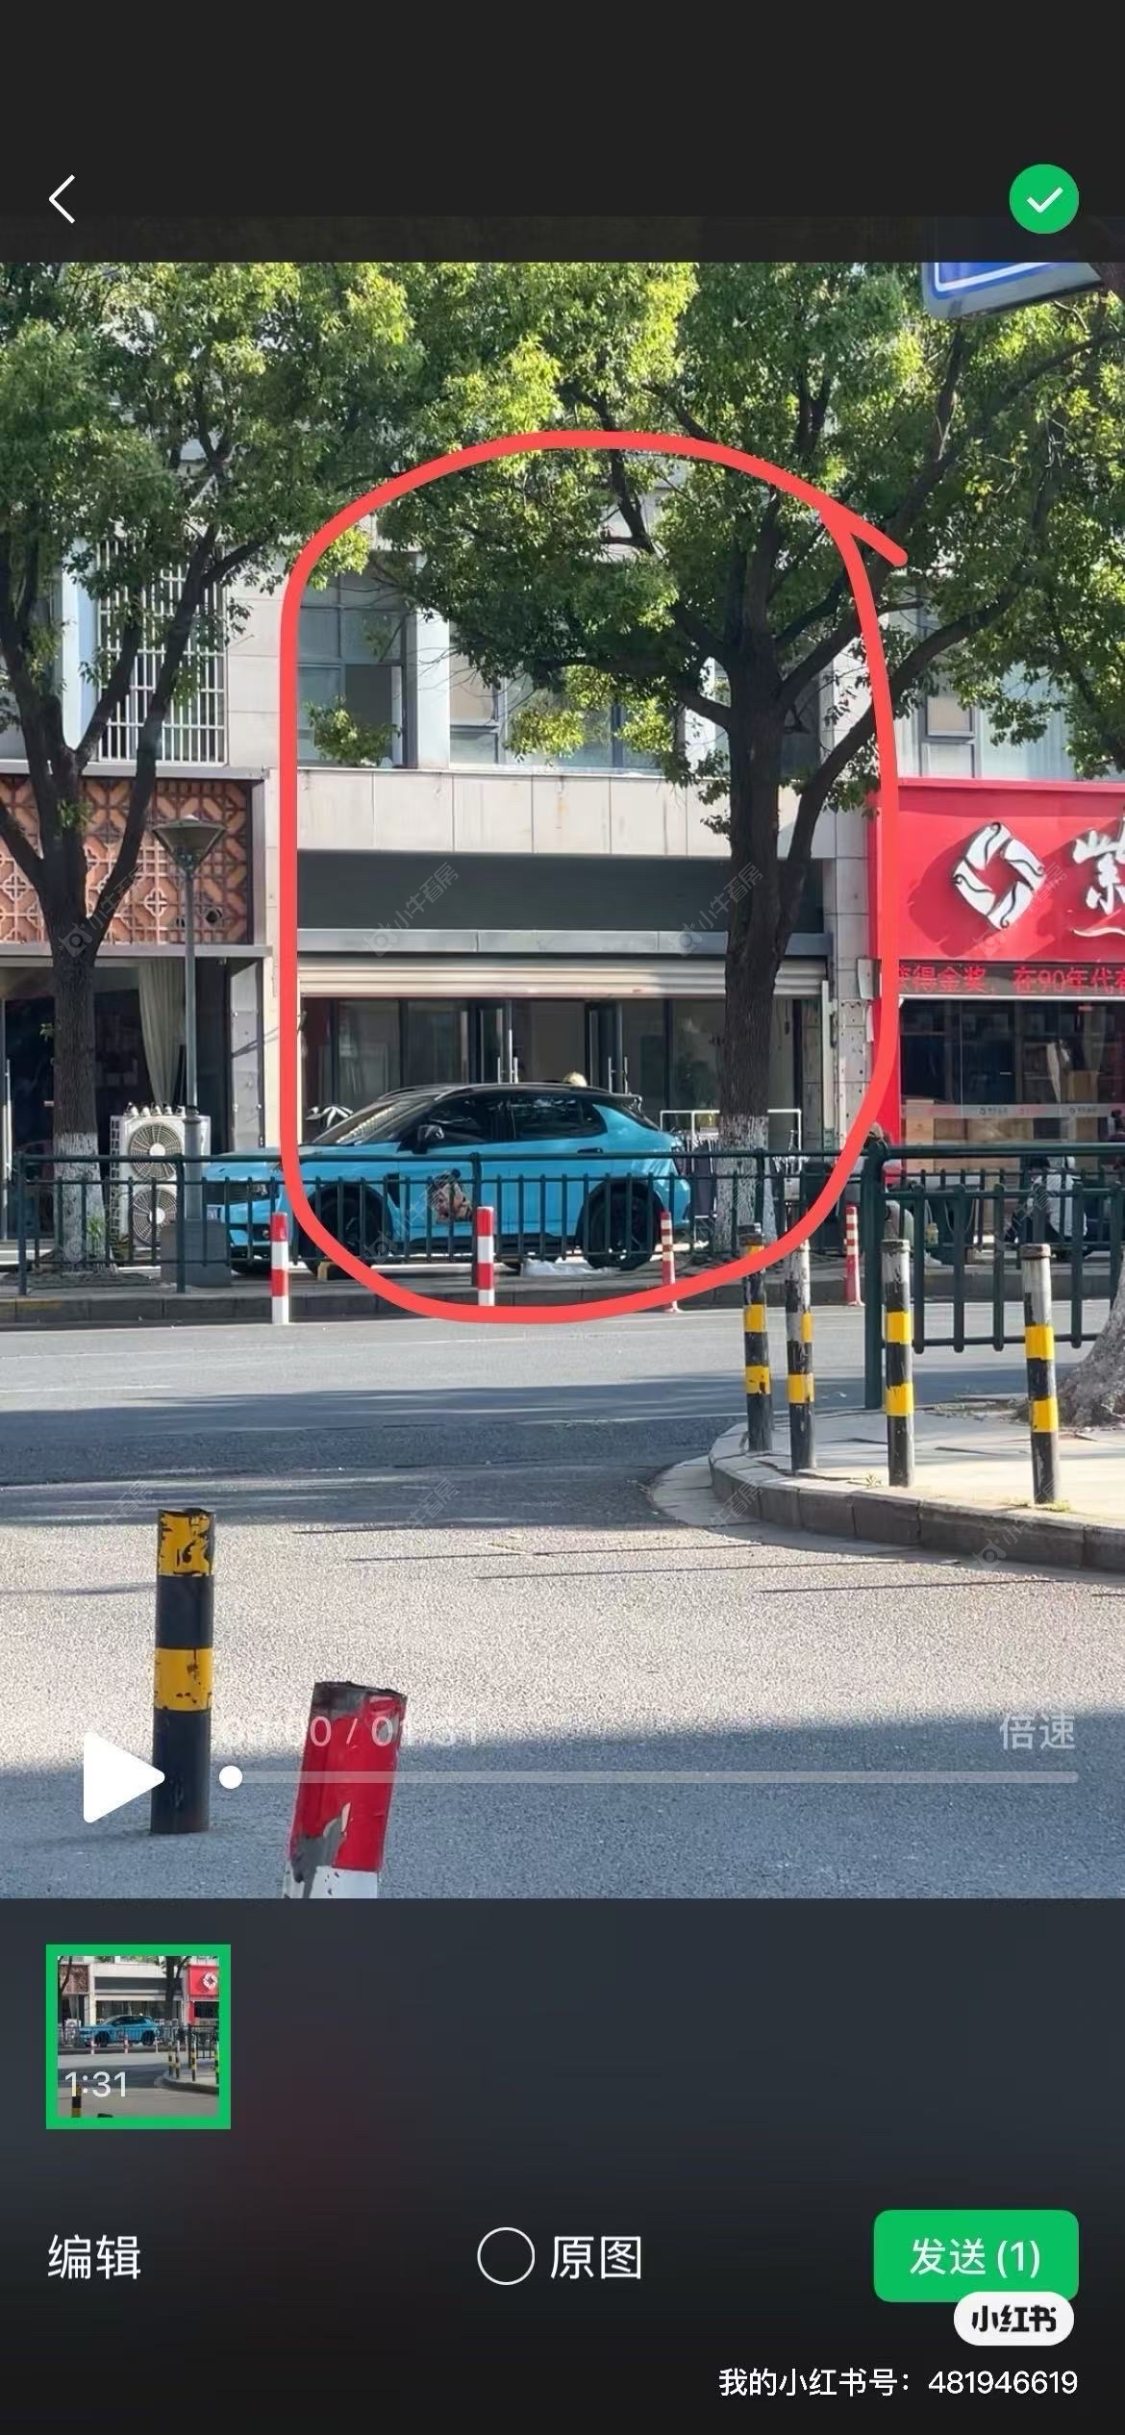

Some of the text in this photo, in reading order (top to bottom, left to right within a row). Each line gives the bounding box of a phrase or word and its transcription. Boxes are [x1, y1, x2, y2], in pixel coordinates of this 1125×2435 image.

[1000, 1713, 1075, 1750] 倍速
[65, 2071, 126, 2097] 1:31
[48, 2234, 141, 2280] 编辑
[550, 2235, 642, 2280] 原图
